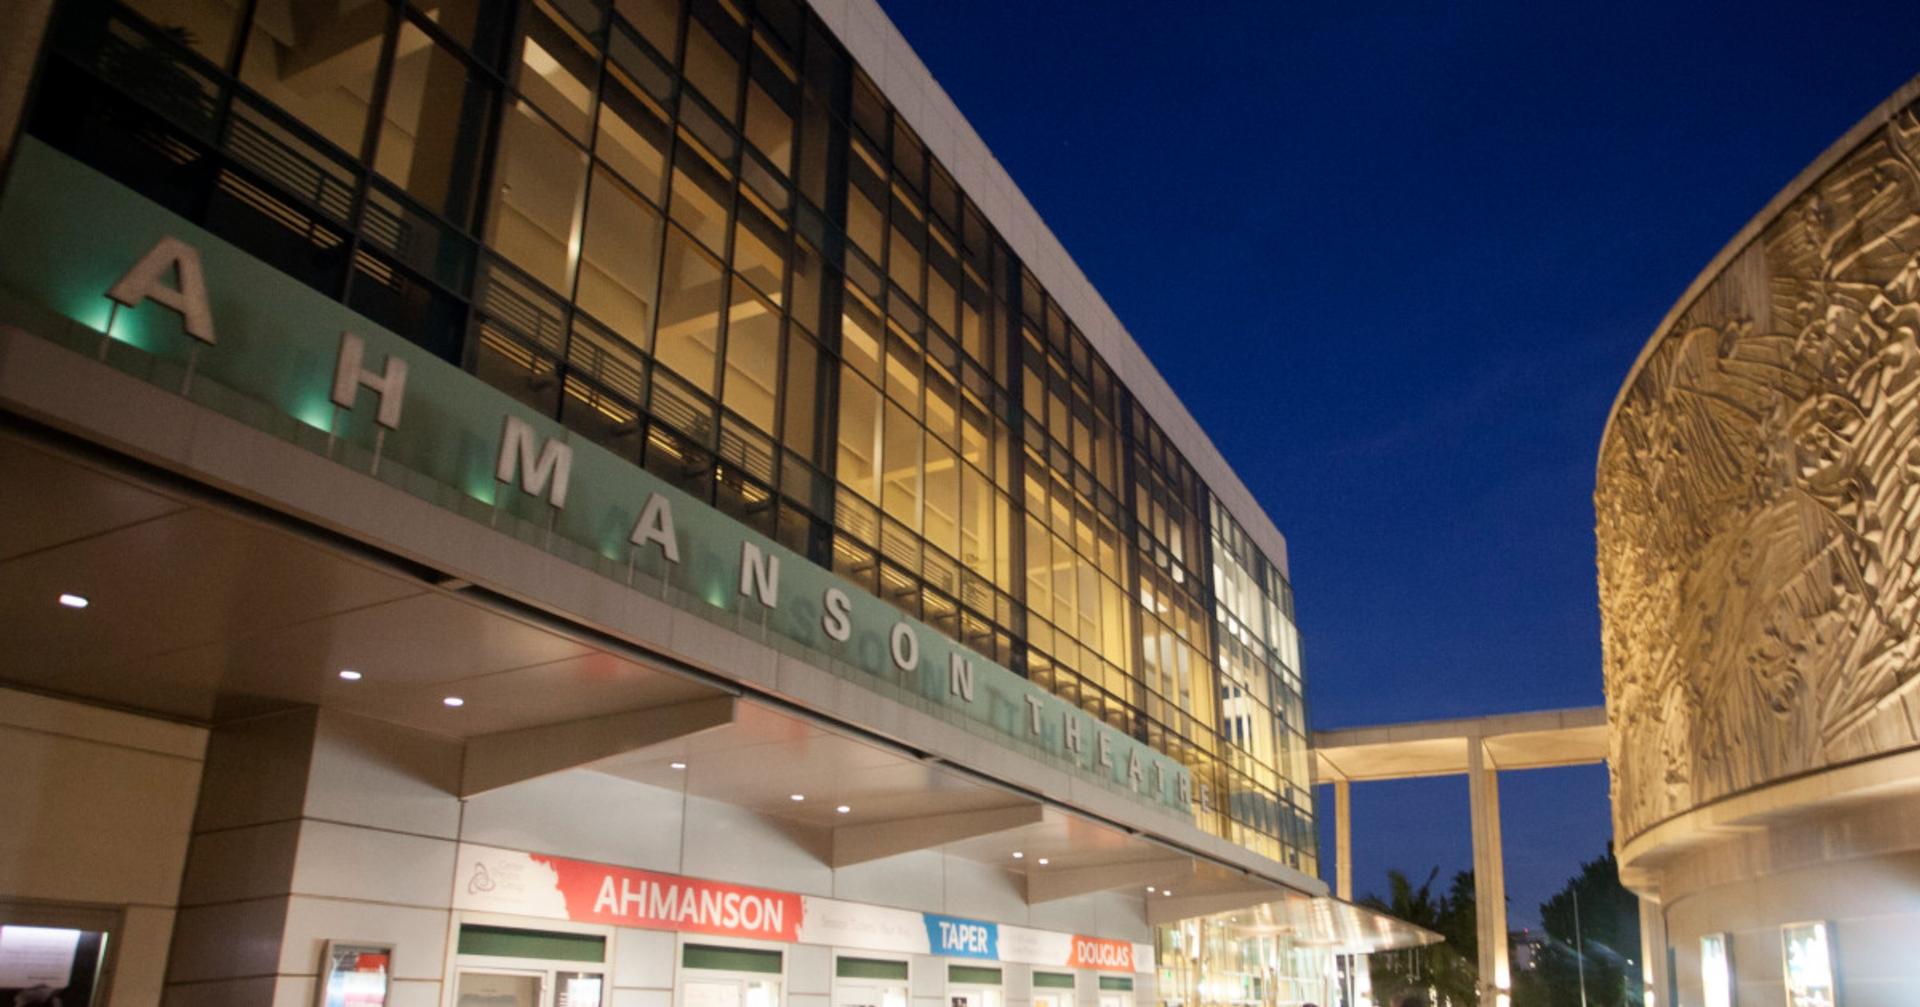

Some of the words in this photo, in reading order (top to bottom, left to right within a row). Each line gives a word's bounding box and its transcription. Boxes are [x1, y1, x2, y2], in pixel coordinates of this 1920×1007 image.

[104, 236, 973, 702] AHMANSON
[1025, 694, 1212, 815] THEATRE
[593, 875, 784, 933] AHMANSON
[939, 921, 988, 953] TAPER
[1077, 940, 1129, 967] DOUGLAS
